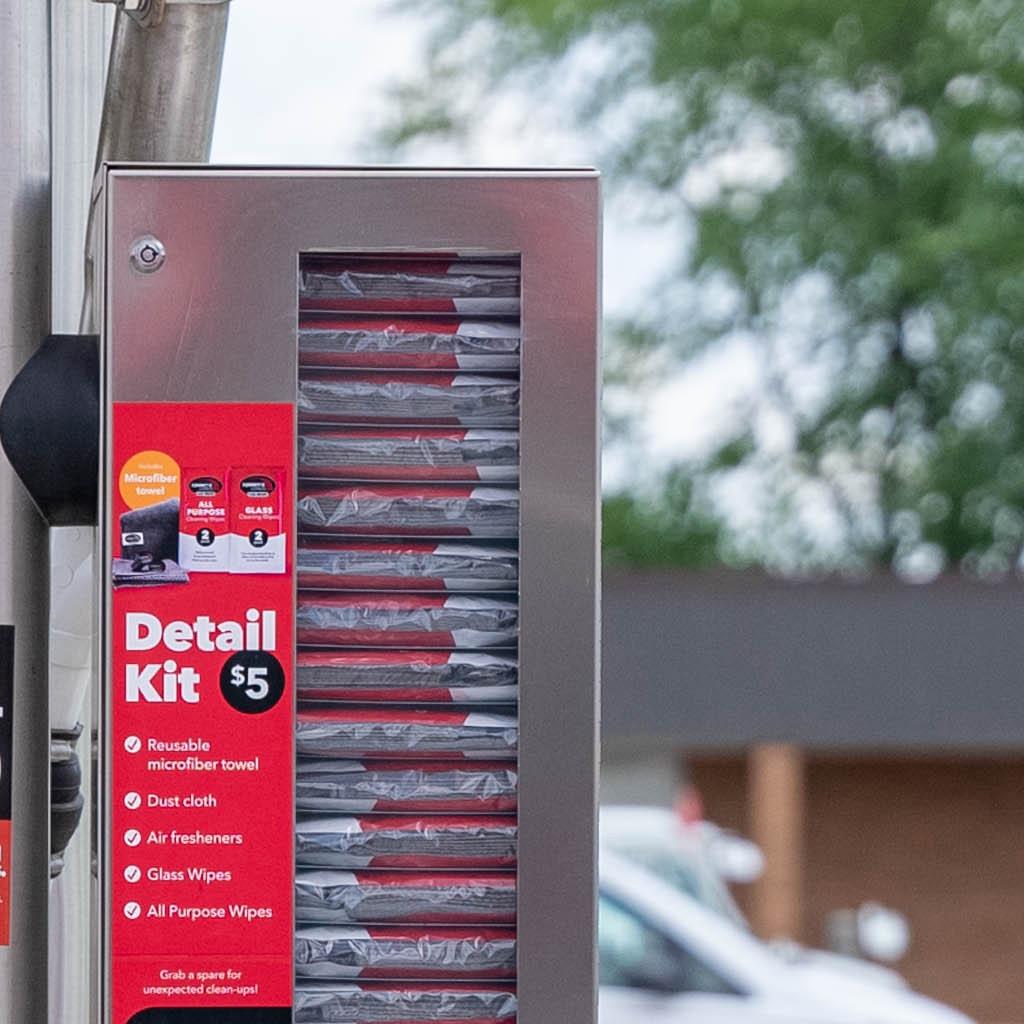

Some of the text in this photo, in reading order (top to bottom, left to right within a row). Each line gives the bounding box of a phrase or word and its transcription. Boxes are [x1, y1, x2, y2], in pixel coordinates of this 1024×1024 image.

[124, 473, 177, 483] Microfiber
[136, 486, 165, 495] towel
[245, 506, 273, 514] GLASS
[200, 530, 210, 540] 2
[254, 530, 264, 540] 2
[126, 608, 276, 652] Detail
[126, 660, 200, 703] Kit
[230, 664, 269, 700] $5
[148, 739, 210, 752] Reusable
[148, 757, 259, 770] microfiber towel
[148, 794, 216, 808] Dust cloth
[146, 830, 243, 844] Air fresheners
[147, 868, 232, 884] Glass Wipes
[147, 904, 272, 921] All Purpose Wipes
[160, 969, 242, 982] Grab a spare for
[143, 984, 258, 996] unexpected clean-ups!
